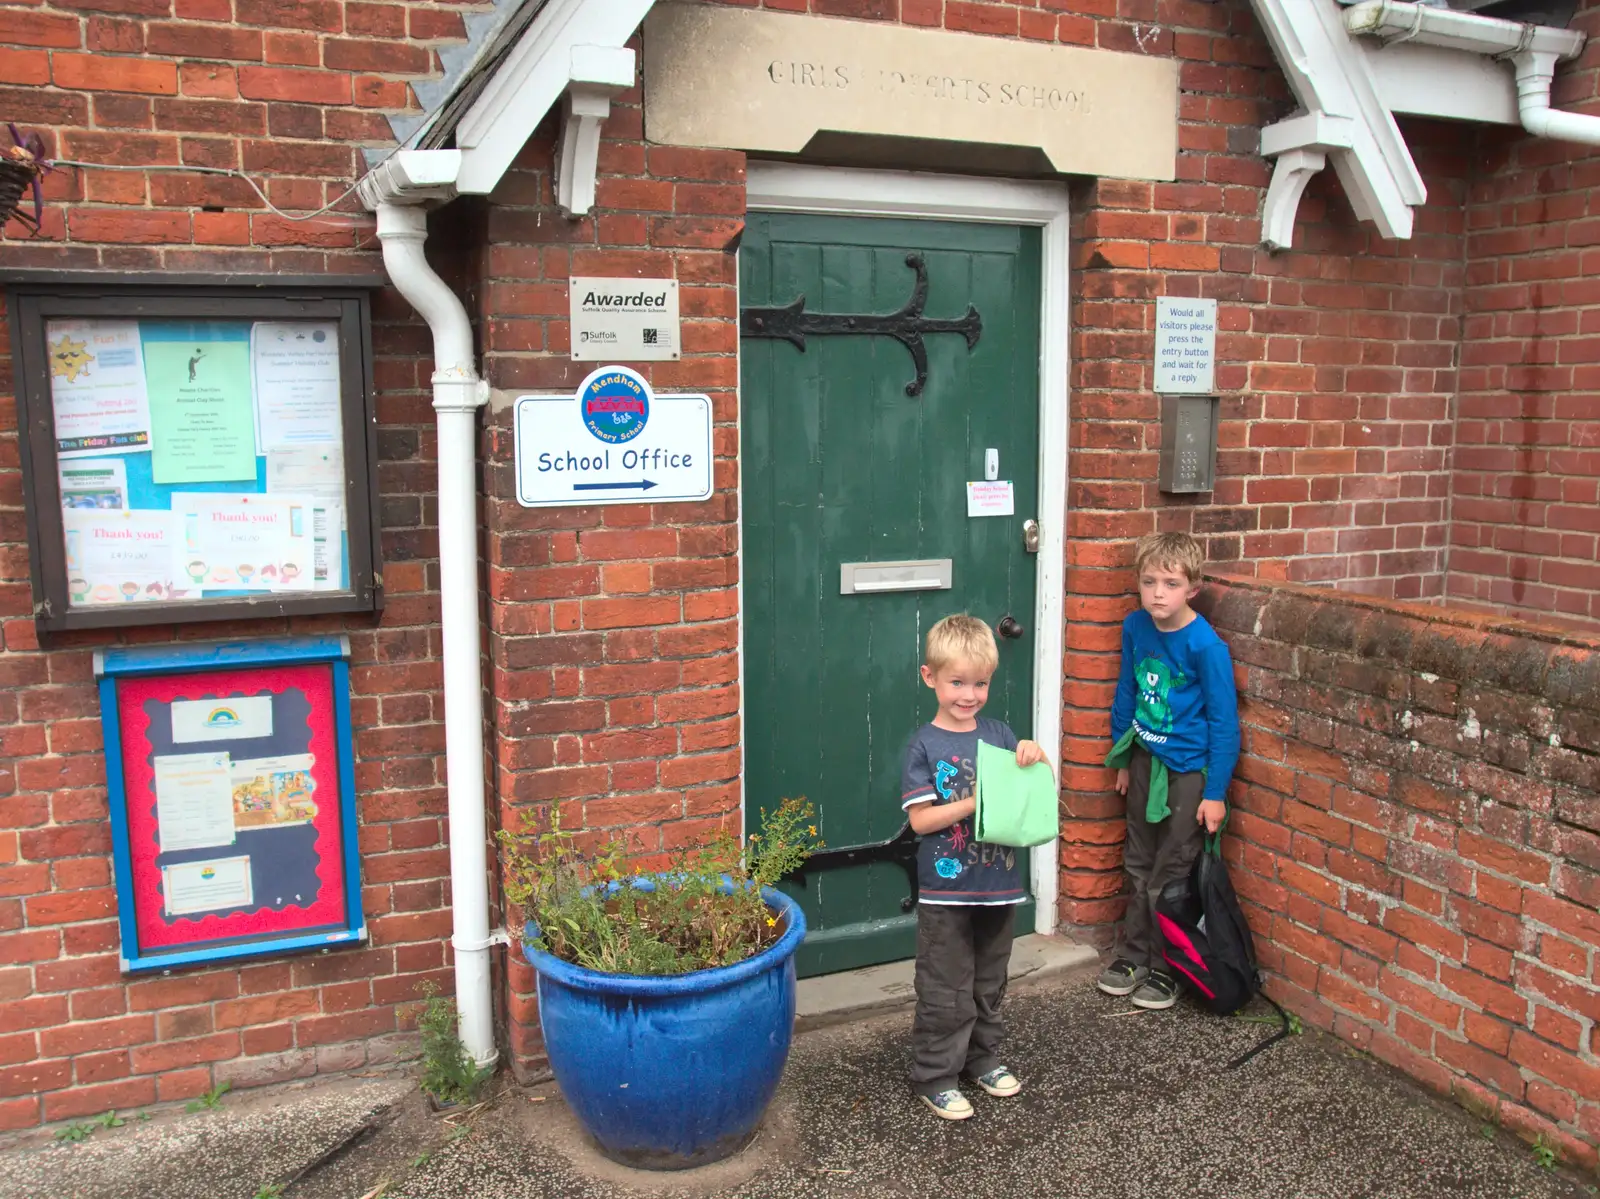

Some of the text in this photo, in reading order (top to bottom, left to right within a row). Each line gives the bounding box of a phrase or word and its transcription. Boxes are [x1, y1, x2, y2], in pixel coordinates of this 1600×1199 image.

[767, 60, 849, 89] GIRLS
[1000, 83, 1092, 115] SCHOOL
[582, 291, 667, 307] Awarded
[1169, 307, 1204, 318] Would all
[1159, 320, 1213, 333] visitors please
[589, 331, 617, 339] Suffolk
[1168, 335, 1203, 344] press the
[1161, 347, 1209, 358] entry button
[1162, 360, 1207, 370] and wait for
[591, 374, 641, 395] Mendham
[1178, 373, 1197, 384] reply
[588, 420, 644, 443] Primary School
[537, 448, 693, 472] School Office
[211, 511, 277, 524] Thank you!
[92, 527, 163, 541] Thank you!
[967, 843, 1006, 866] SEA
